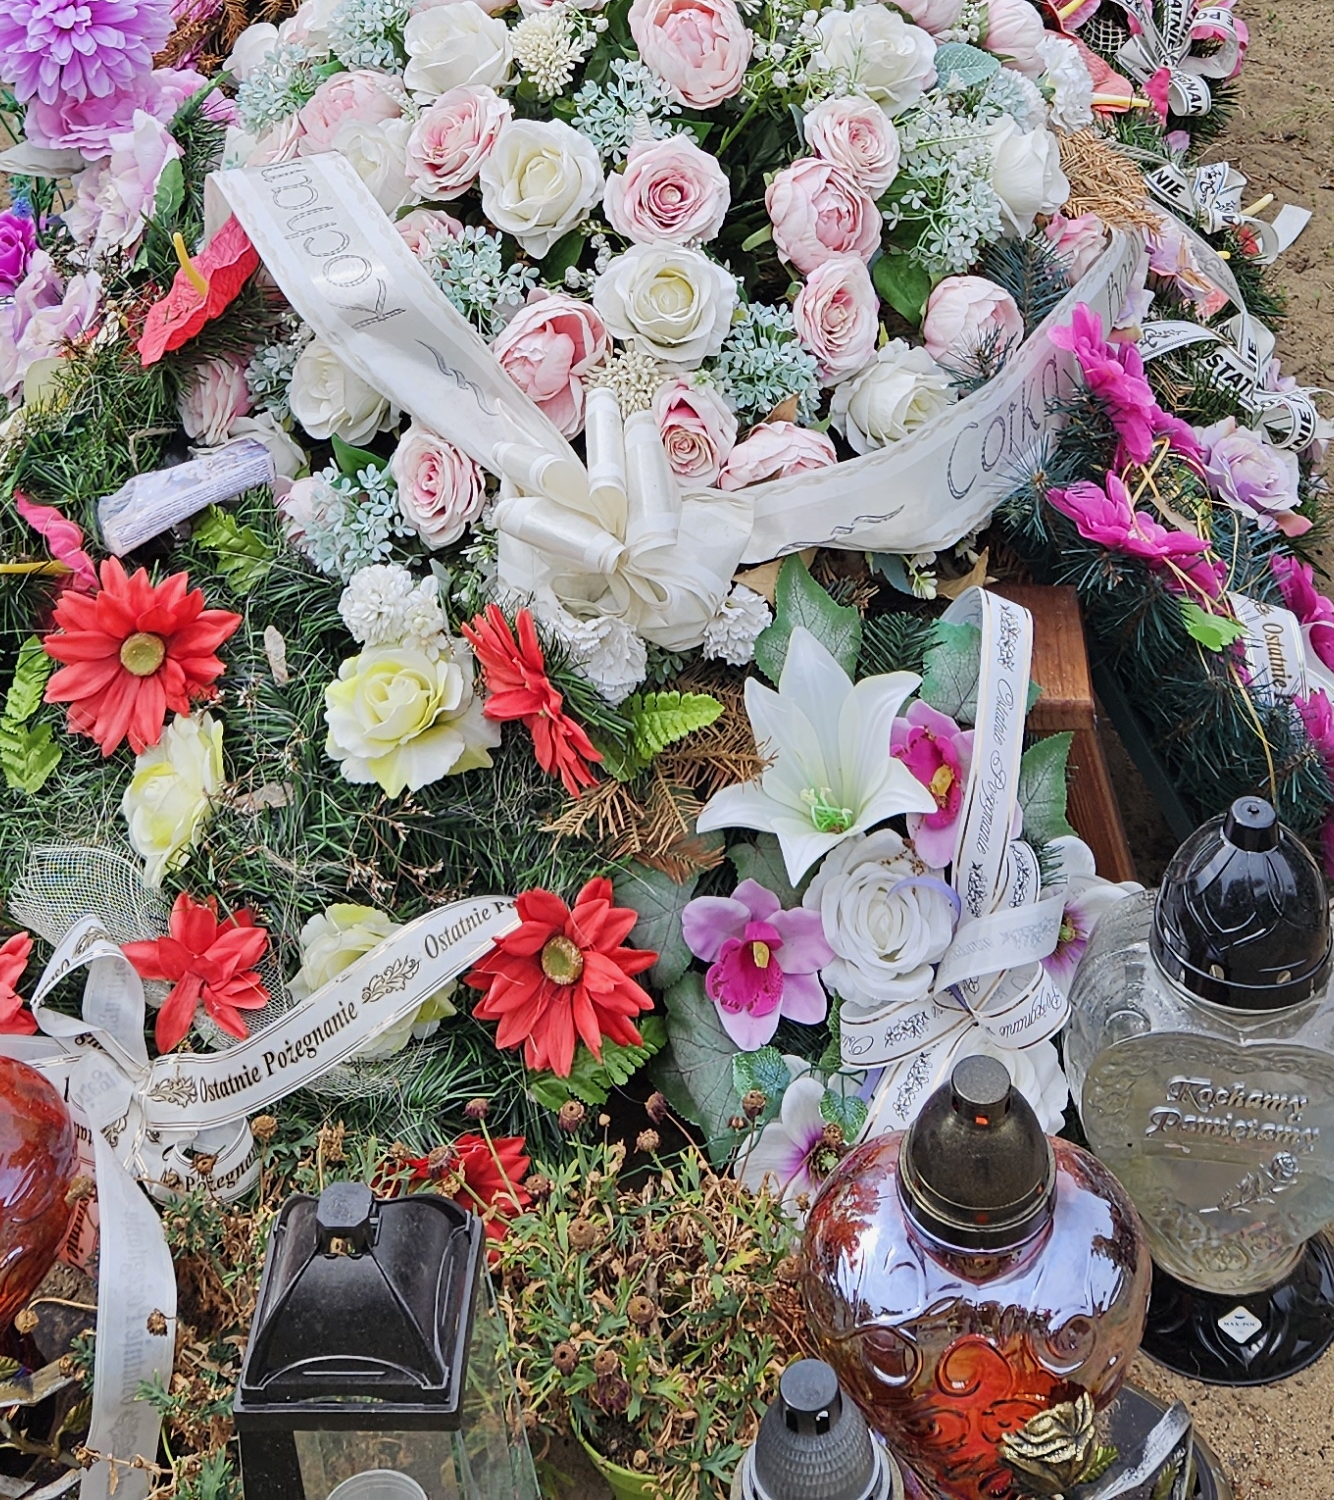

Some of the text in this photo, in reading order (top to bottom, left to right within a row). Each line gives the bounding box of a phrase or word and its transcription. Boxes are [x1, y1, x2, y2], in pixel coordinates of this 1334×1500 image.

[1261, 622, 1293, 689] Ostatnie
[424, 908, 492, 960] Ostatnie
[198, 998, 359, 1104] Ostatnie Pożegnanie
[1166, 1075, 1309, 1125] Kochamy
[1145, 1105, 1320, 1154] Pamiętamy
